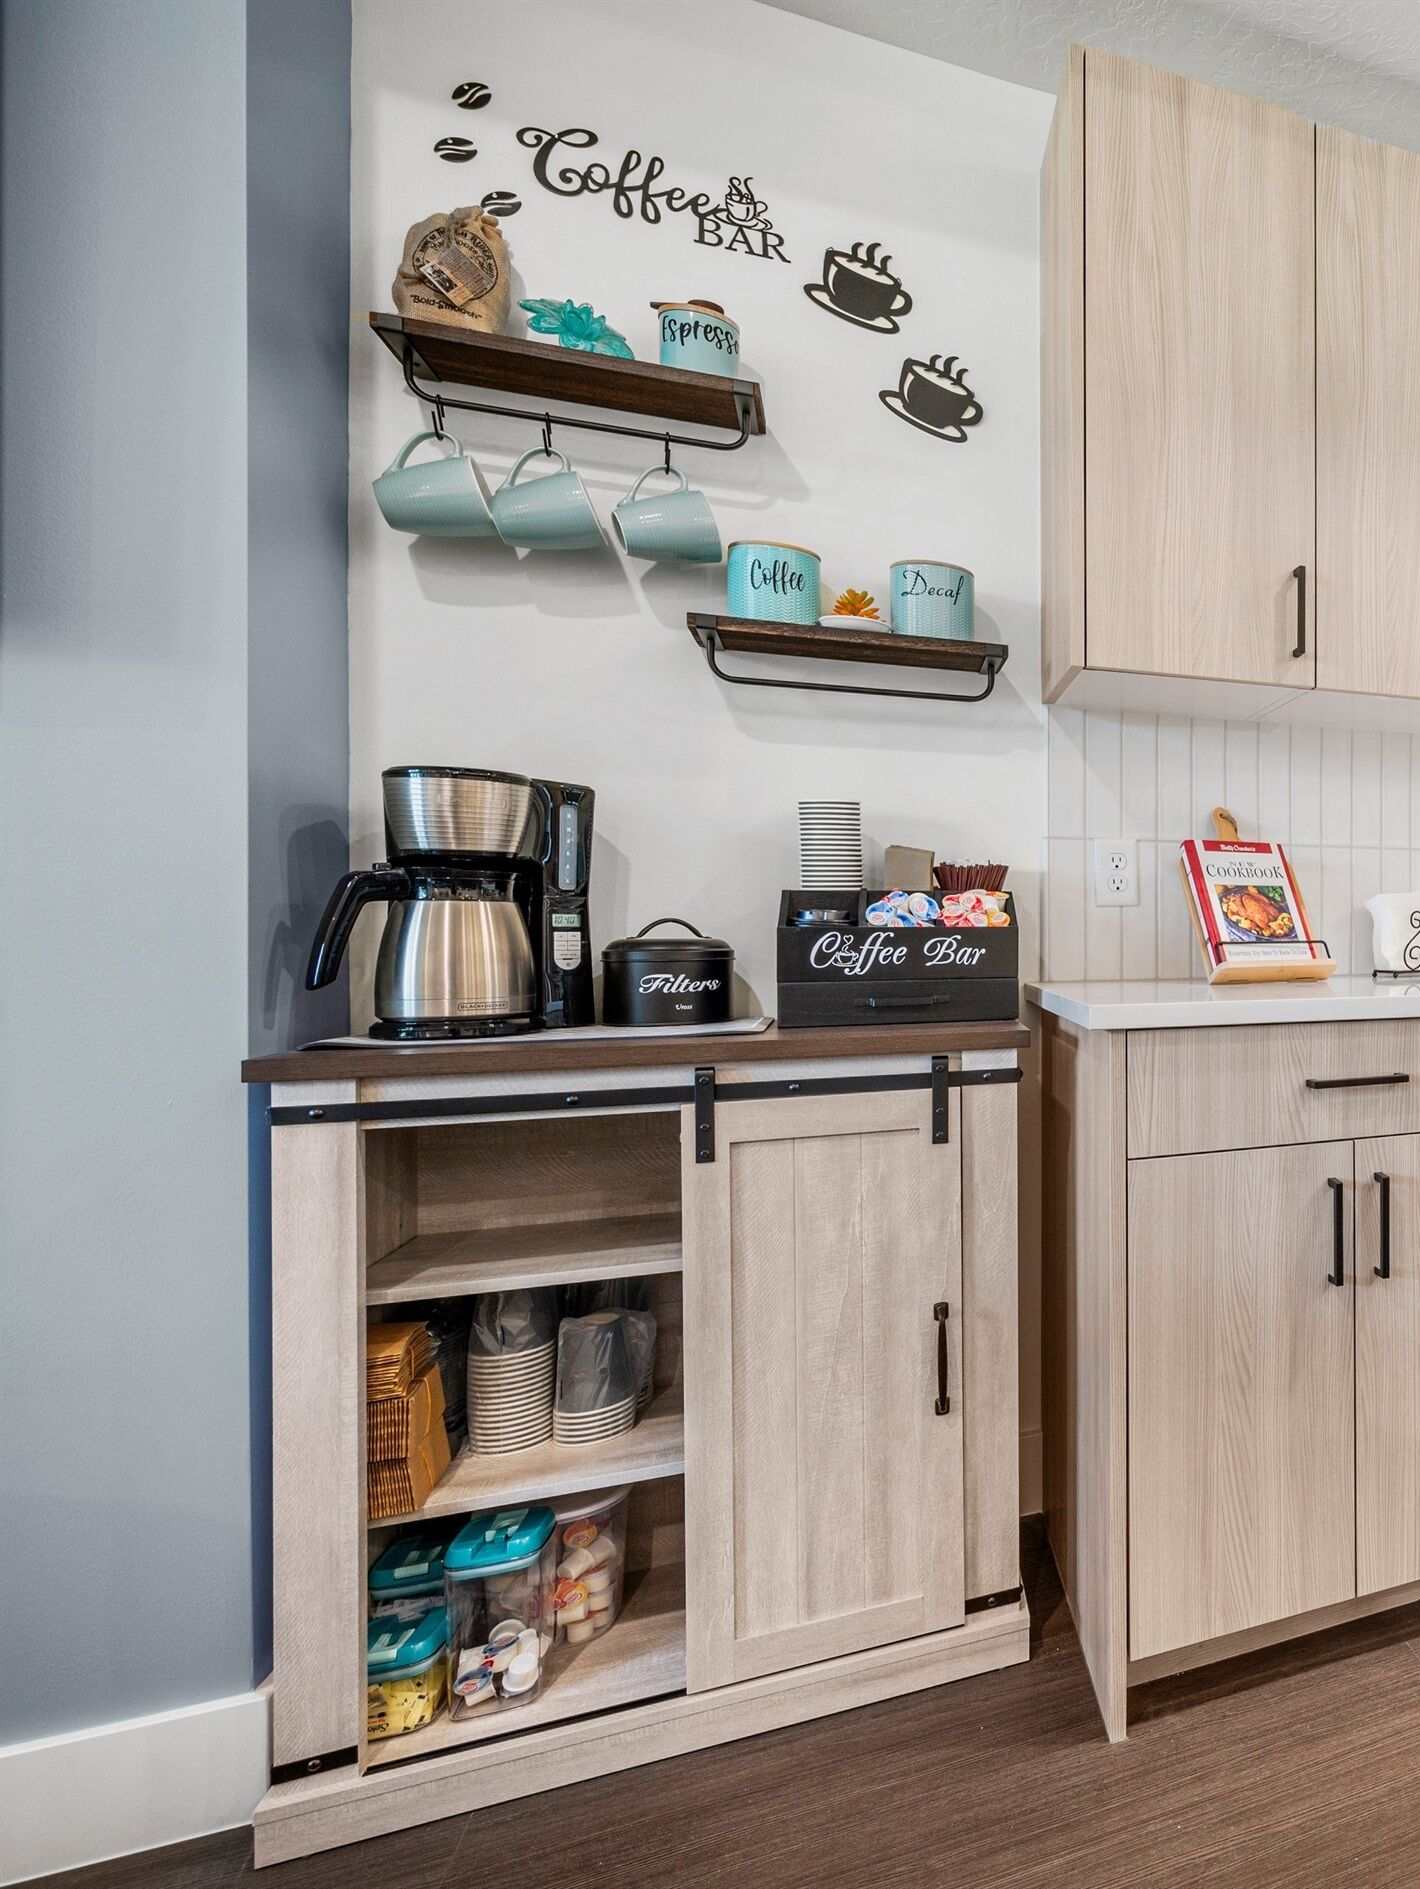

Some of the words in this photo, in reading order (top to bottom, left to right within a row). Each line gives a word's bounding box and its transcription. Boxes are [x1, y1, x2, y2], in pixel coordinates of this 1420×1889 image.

[516, 127, 721, 225] Coffee
[694, 217, 791, 263] BAR
[750, 558, 805, 595] Coffee
[901, 570, 964, 605] Decaf
[1206, 863, 1284, 879] COOKBOOK
[923, 934, 986, 967] Bar
[639, 973, 721, 994] Filters
